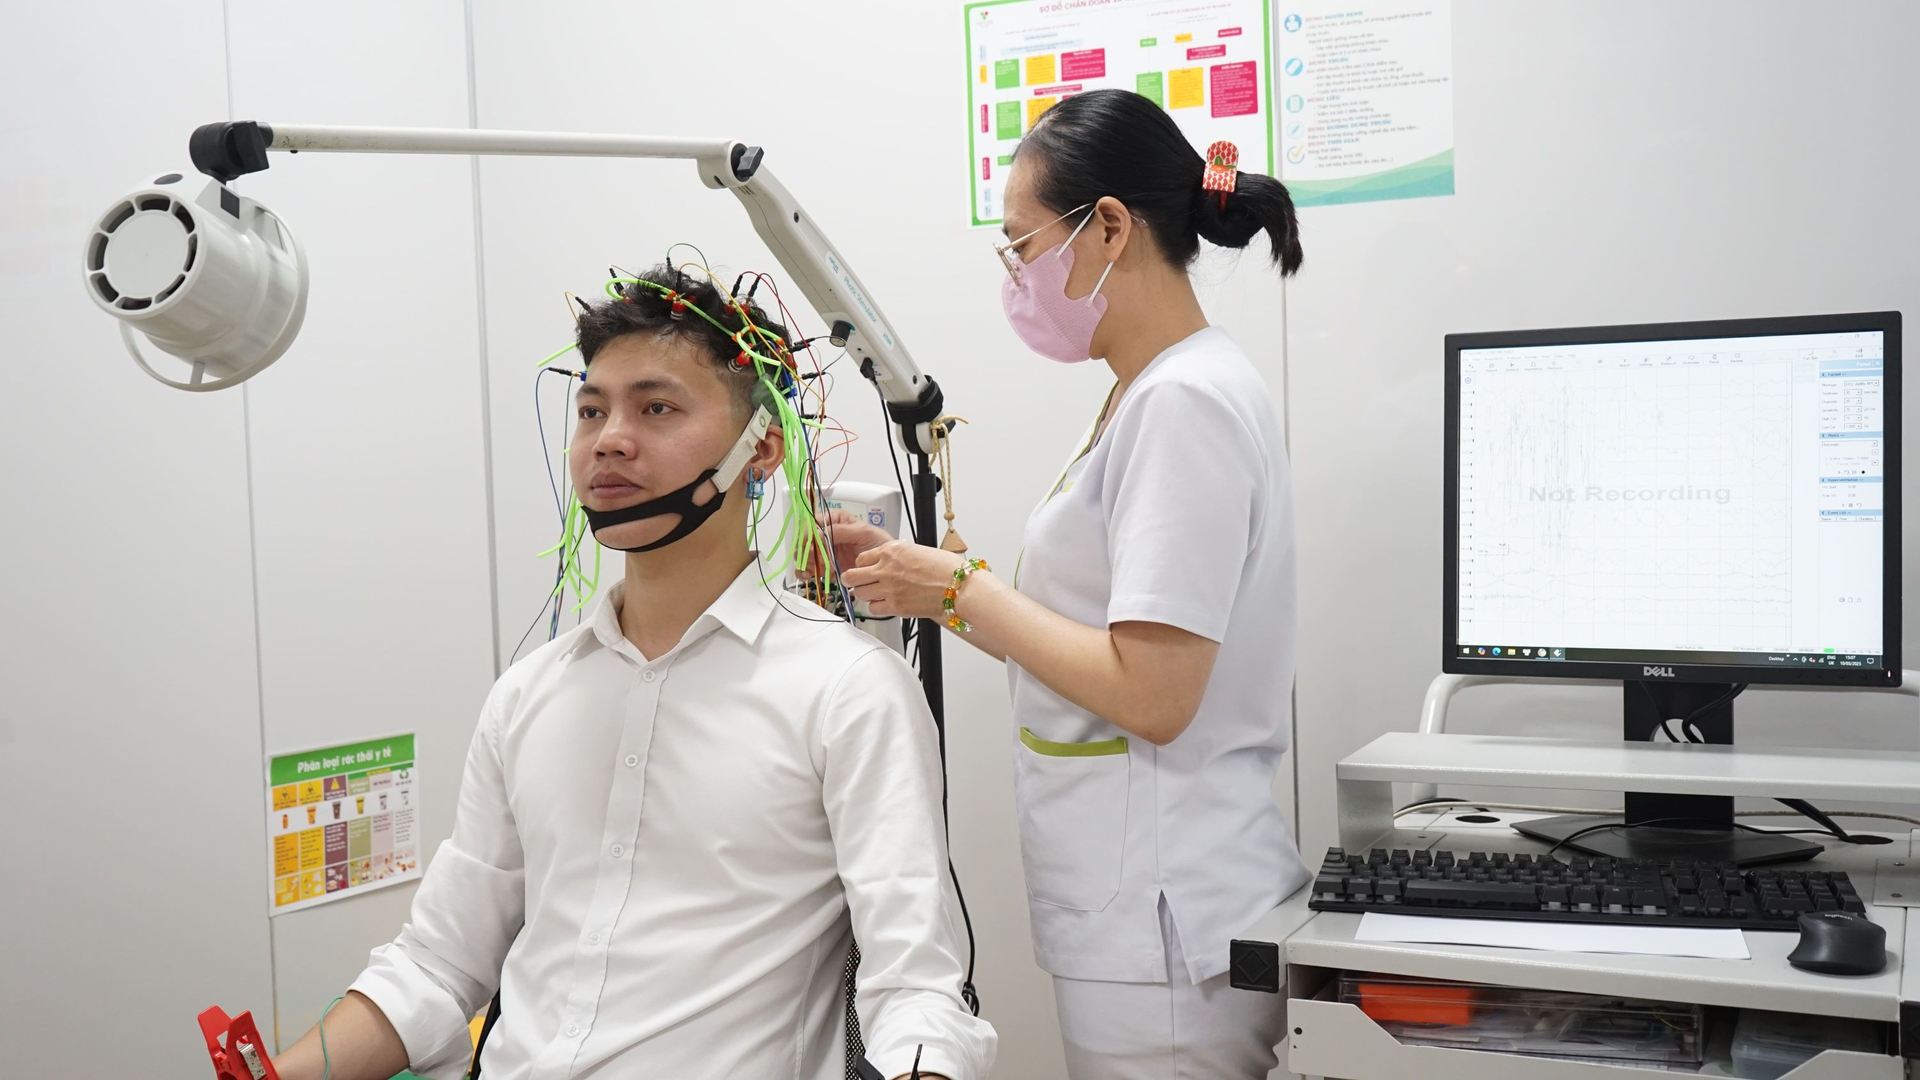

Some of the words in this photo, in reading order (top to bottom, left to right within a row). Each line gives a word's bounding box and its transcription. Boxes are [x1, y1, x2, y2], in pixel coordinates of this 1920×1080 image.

[1039, 5, 1050, 13] SƠ
[1051, 1, 1062, 11] ĐỒ
[844, 276, 856, 297] Photic
[856, 293, 876, 323] Stimulator
[1529, 486, 1576, 502] Not
[1585, 485, 1730, 505] Recording
[1643, 665, 1675, 677] DELL
[297, 760, 320, 774] Phân
[323, 757, 339, 771] loại
[342, 753, 355, 765] rác
[356, 750, 373, 762] thải
[375, 750, 381, 761] y
[383, 745, 392, 756] tế
[1824, 913, 1853, 921] logitech
